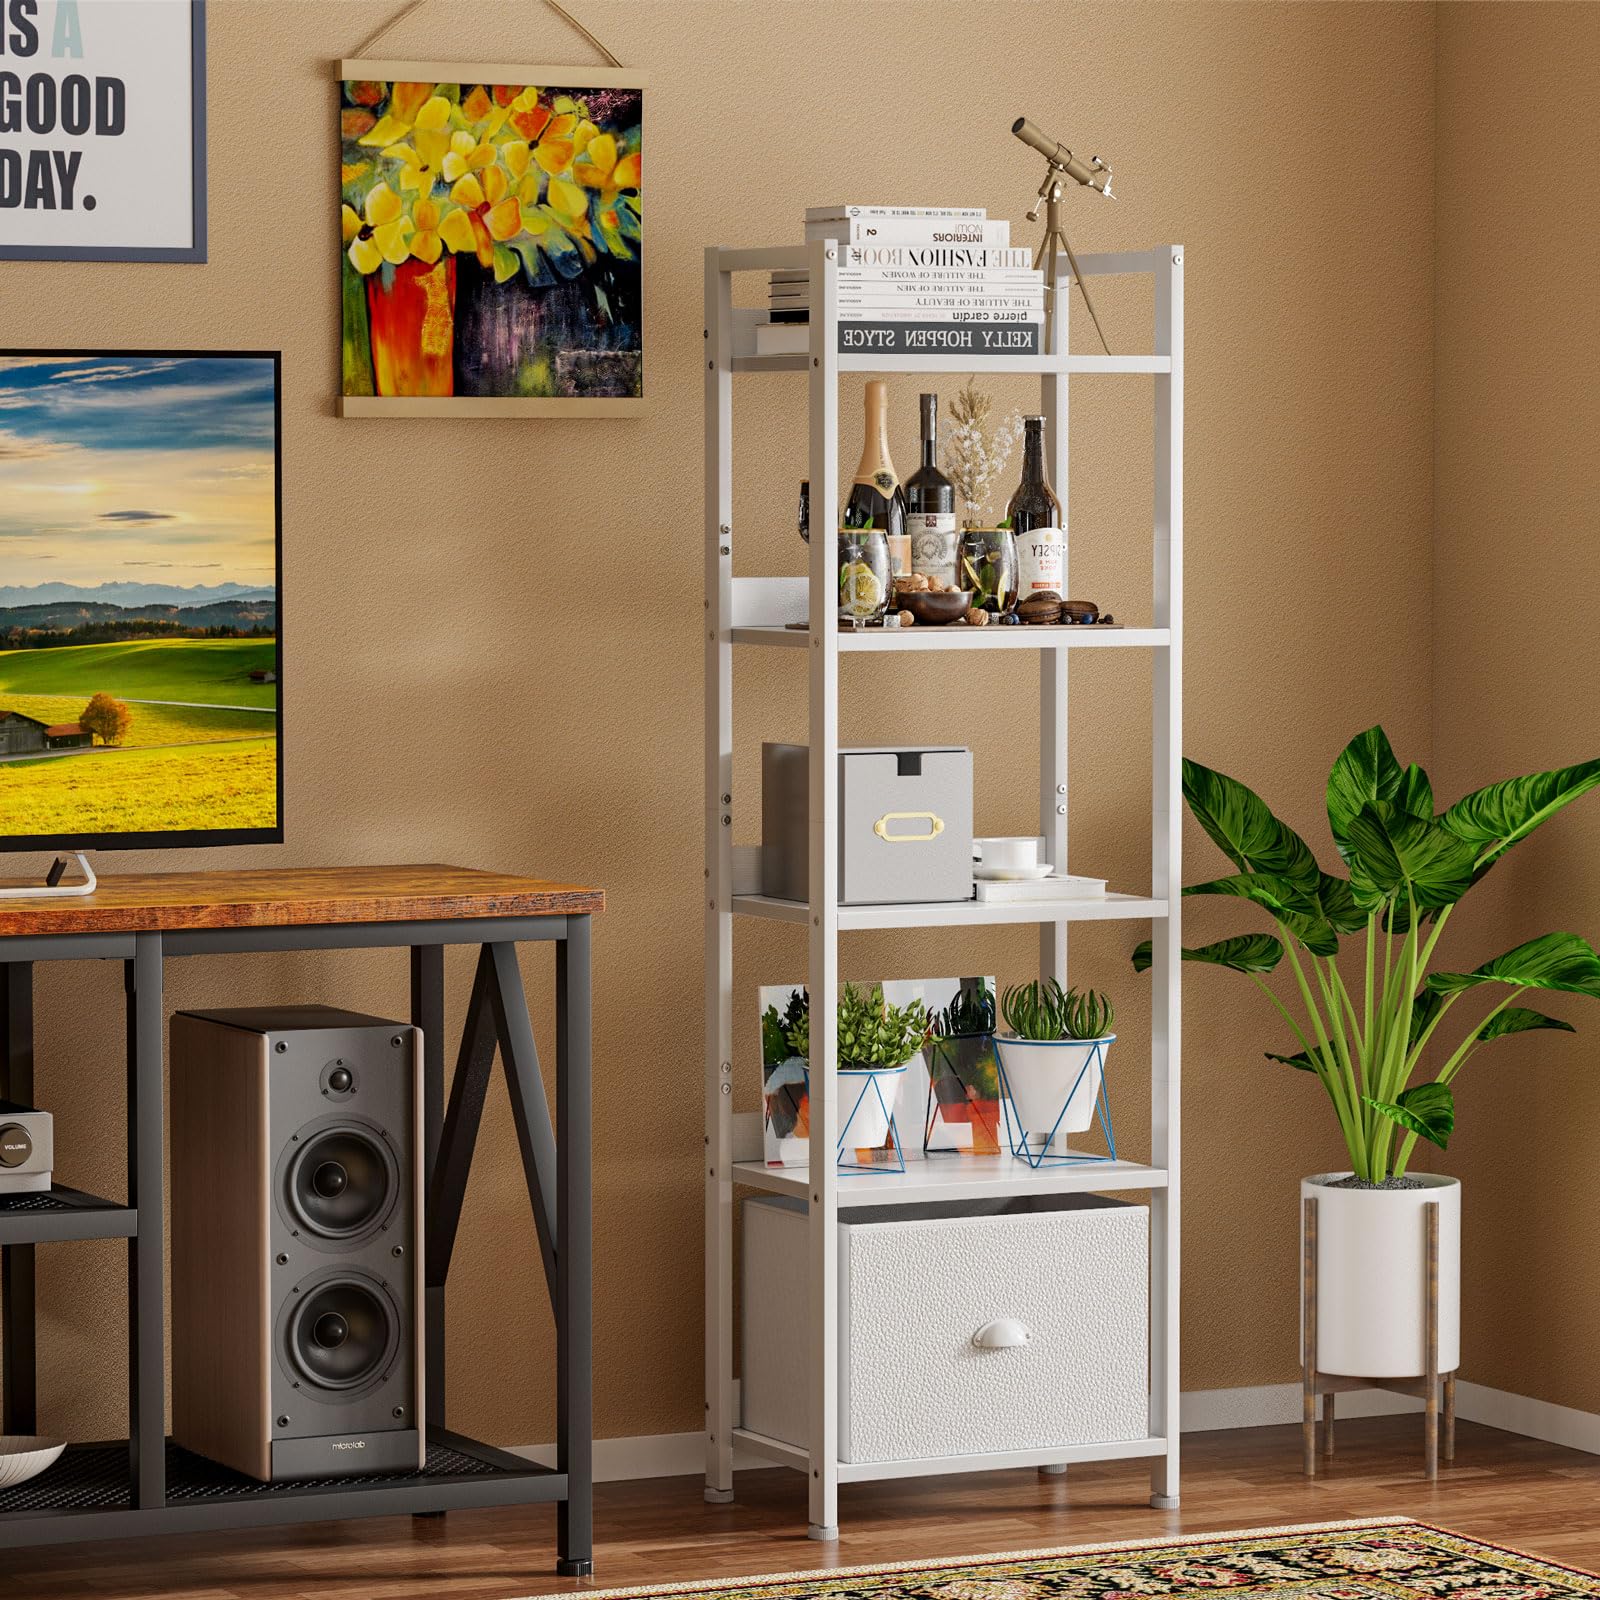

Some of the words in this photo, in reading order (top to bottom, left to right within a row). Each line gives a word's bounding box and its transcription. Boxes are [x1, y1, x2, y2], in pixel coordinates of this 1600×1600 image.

[52, 0, 84, 58] A
[0, 71, 126, 137] GOOD
[0, 149, 97, 211] DAY.
[955, 223, 983, 233] NOW!
[933, 233, 983, 242] INTERIORS
[908, 248, 987, 267] FASHION
[992, 249, 1030, 267] THE
[915, 298, 955, 306] BEAUTY
[974, 299, 1009, 307] ALLURE
[1012, 299, 1032, 307] THE
[953, 312, 989, 322] cardin
[993, 311, 1027, 323] pierre
[332, 1440, 366, 1450] microlab
